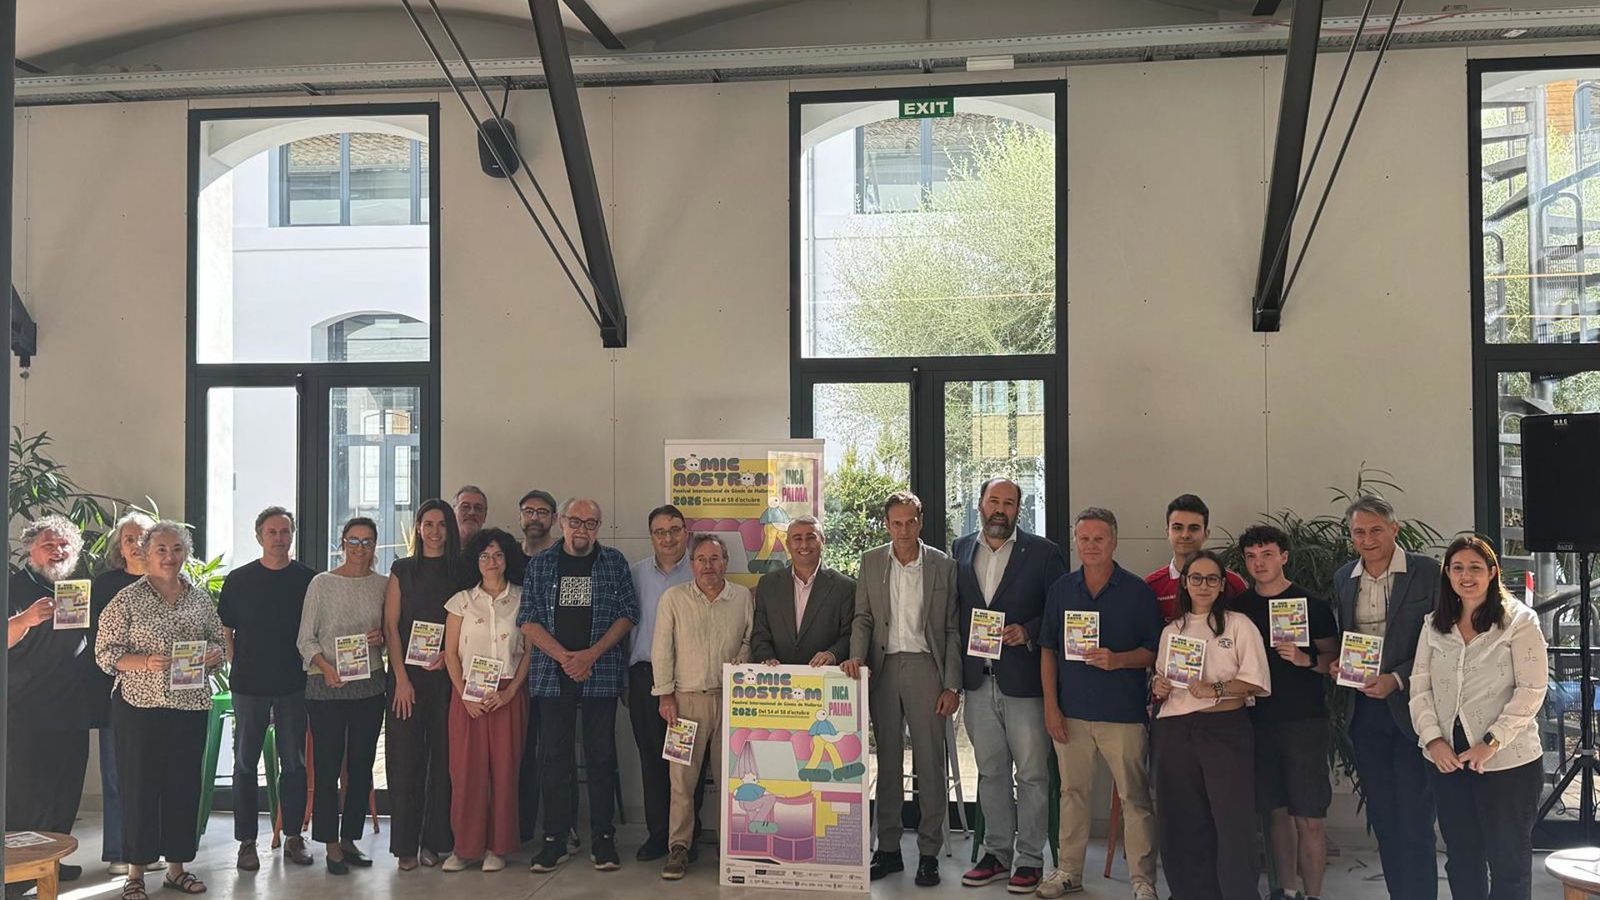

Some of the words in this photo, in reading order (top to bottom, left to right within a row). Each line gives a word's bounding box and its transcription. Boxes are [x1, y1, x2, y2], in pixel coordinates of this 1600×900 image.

[904, 101, 948, 115] EXIT
[785, 469, 804, 485] INCA
[673, 496, 702, 506] 2026
[782, 487, 808, 502] PALMA
[832, 686, 849, 700] INCA
[732, 707, 757, 716] 2026
[829, 702, 852, 716] PALMA
